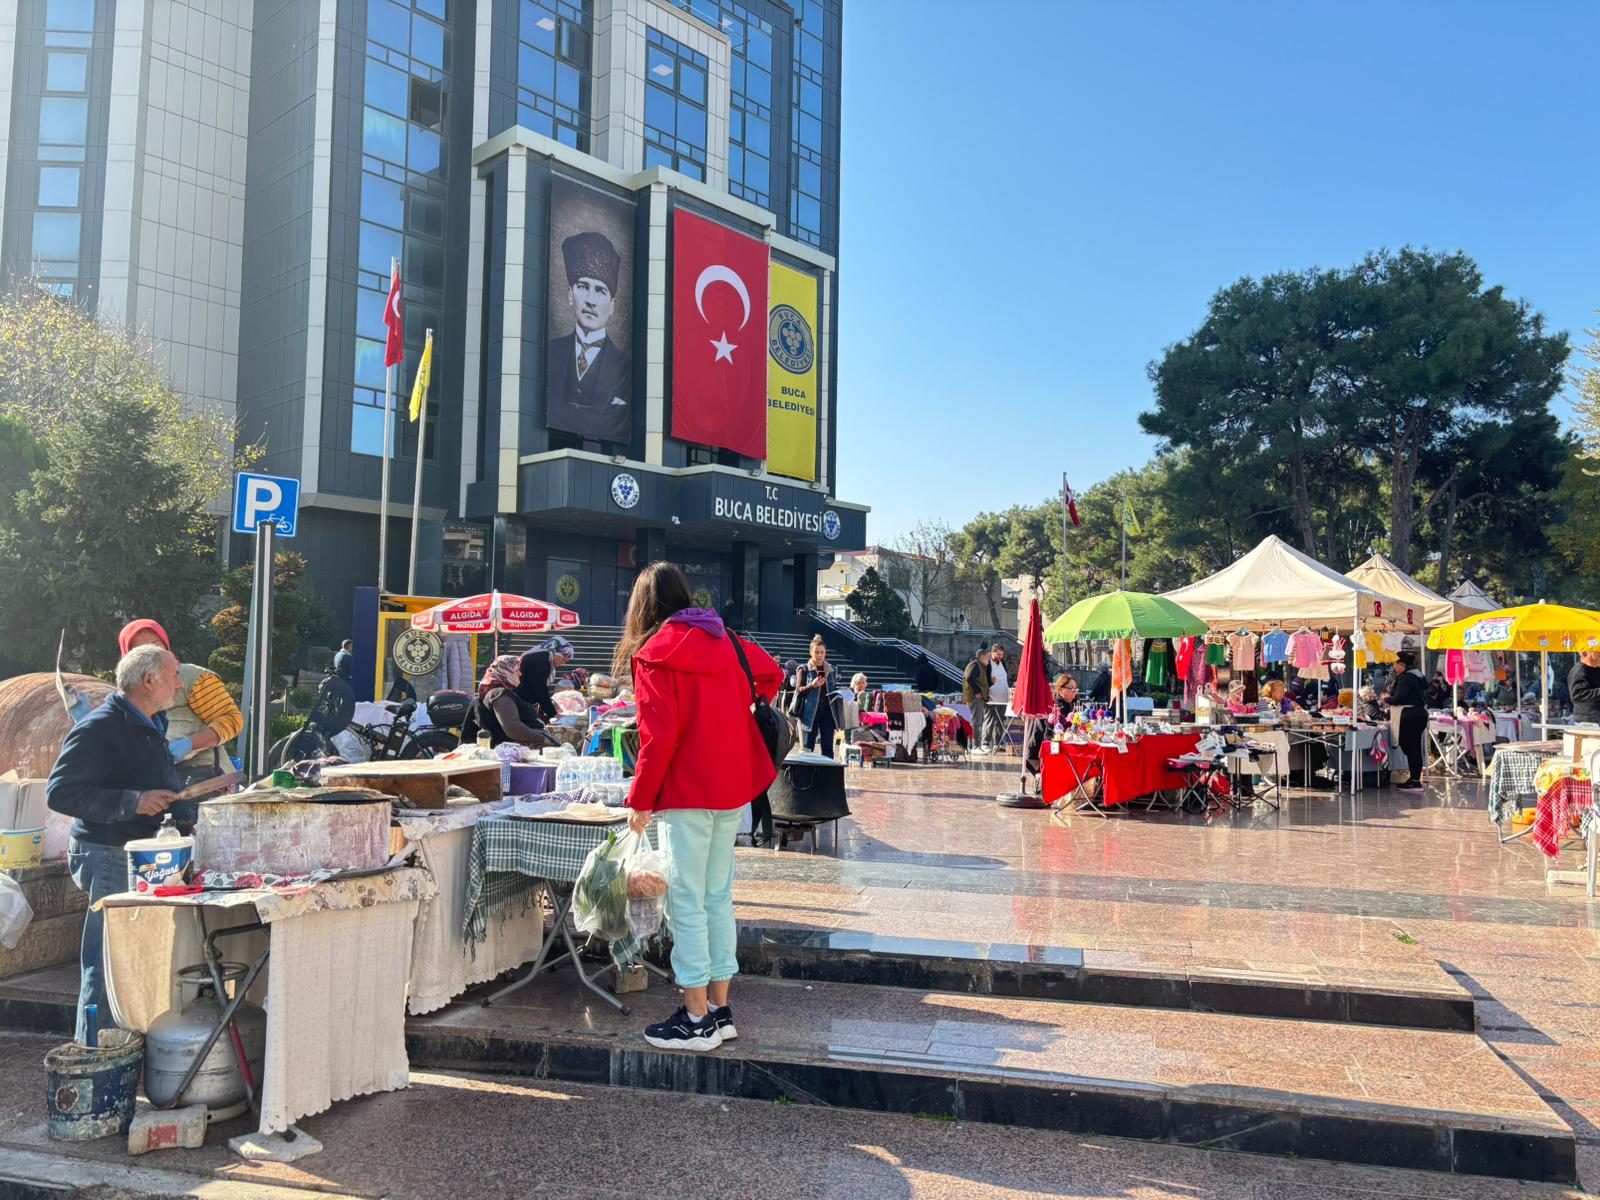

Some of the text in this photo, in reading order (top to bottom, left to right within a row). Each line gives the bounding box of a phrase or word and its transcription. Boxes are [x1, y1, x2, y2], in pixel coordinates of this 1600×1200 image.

[778, 311, 802, 326] BUCA
[781, 385, 806, 399] BUCA
[244, 478, 282, 528] P
[714, 497, 753, 522] BUCA
[756, 504, 822, 533] BELEDİYESİ
[405, 631, 430, 640] BUCA
[1466, 624, 1509, 644] Tea
[397, 654, 438, 672] BELEDİYESİ
